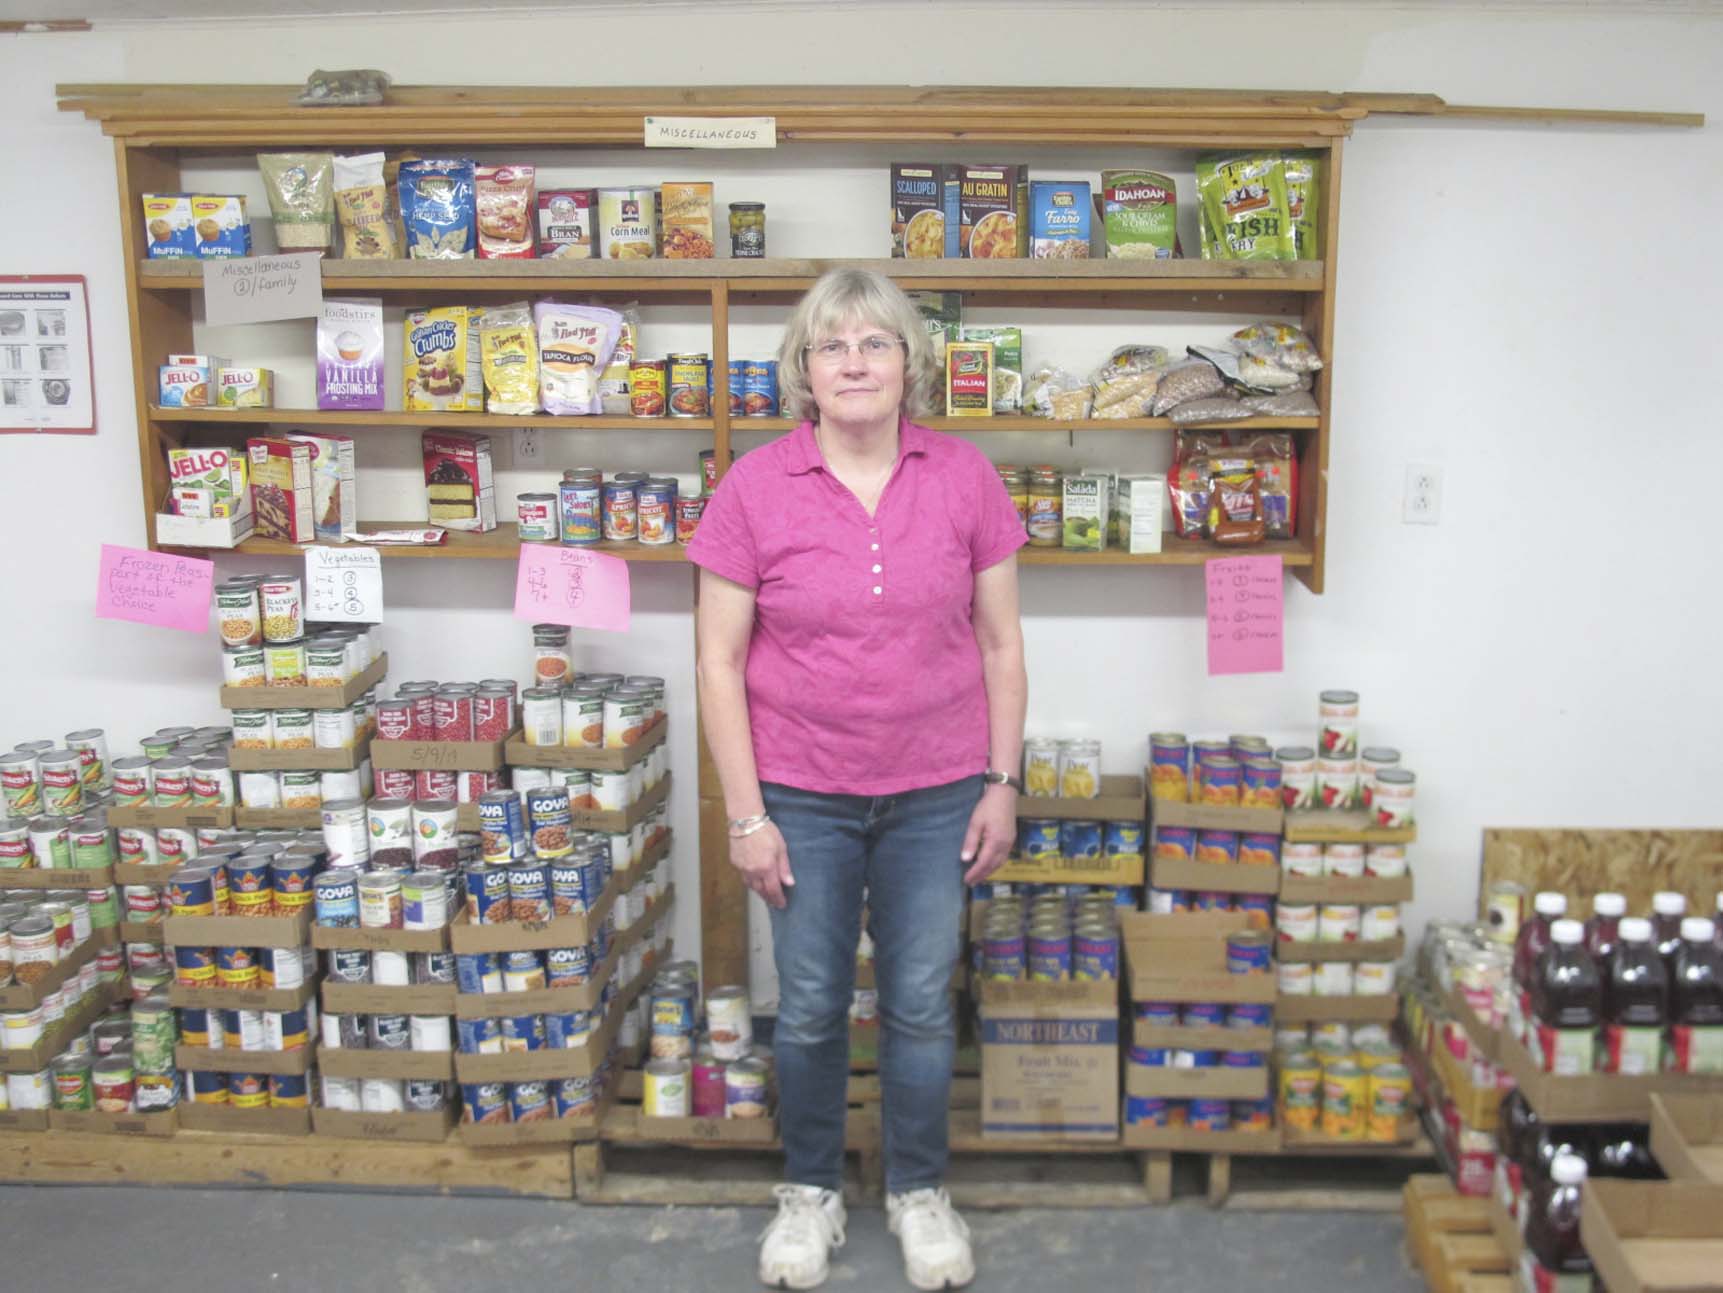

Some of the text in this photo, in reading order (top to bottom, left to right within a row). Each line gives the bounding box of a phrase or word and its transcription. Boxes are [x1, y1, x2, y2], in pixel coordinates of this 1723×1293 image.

[660, 127, 758, 140] MISCELLANEOUS
[896, 180, 937, 195] SCALLOPED
[962, 182, 1008, 197] AU GRATIN
[1115, 190, 1165, 201] IDAHOAN
[1045, 210, 1081, 224] Farro
[551, 229, 580, 238] BRAN
[610, 225, 650, 237] Corn Meal
[1226, 218, 1279, 239] FISH
[222, 260, 301, 277] Miscellaneous
[325, 307, 376, 319] foodstirs
[415, 331, 456, 357] Crumbs
[544, 351, 594, 363] TAPIOCA FLOUR
[166, 371, 201, 385] JELL-O
[221, 371, 254, 386] JELL-O
[326, 367, 378, 384] VANILLA
[326, 383, 378, 395] FROSTING MIX
[953, 379, 986, 388] ITALIAN
[171, 450, 228, 479] JELL-O
[1067, 483, 1097, 495] Salada
[120, 556, 170, 574] Frozen
[320, 551, 376, 565] Vegetables
[480, 805, 503, 817] OYA
[487, 872, 504, 886] GO
[553, 870, 578, 882] OYA
[318, 886, 354, 900] GOYA
[996, 1023, 1100, 1042] NORTHEAST
